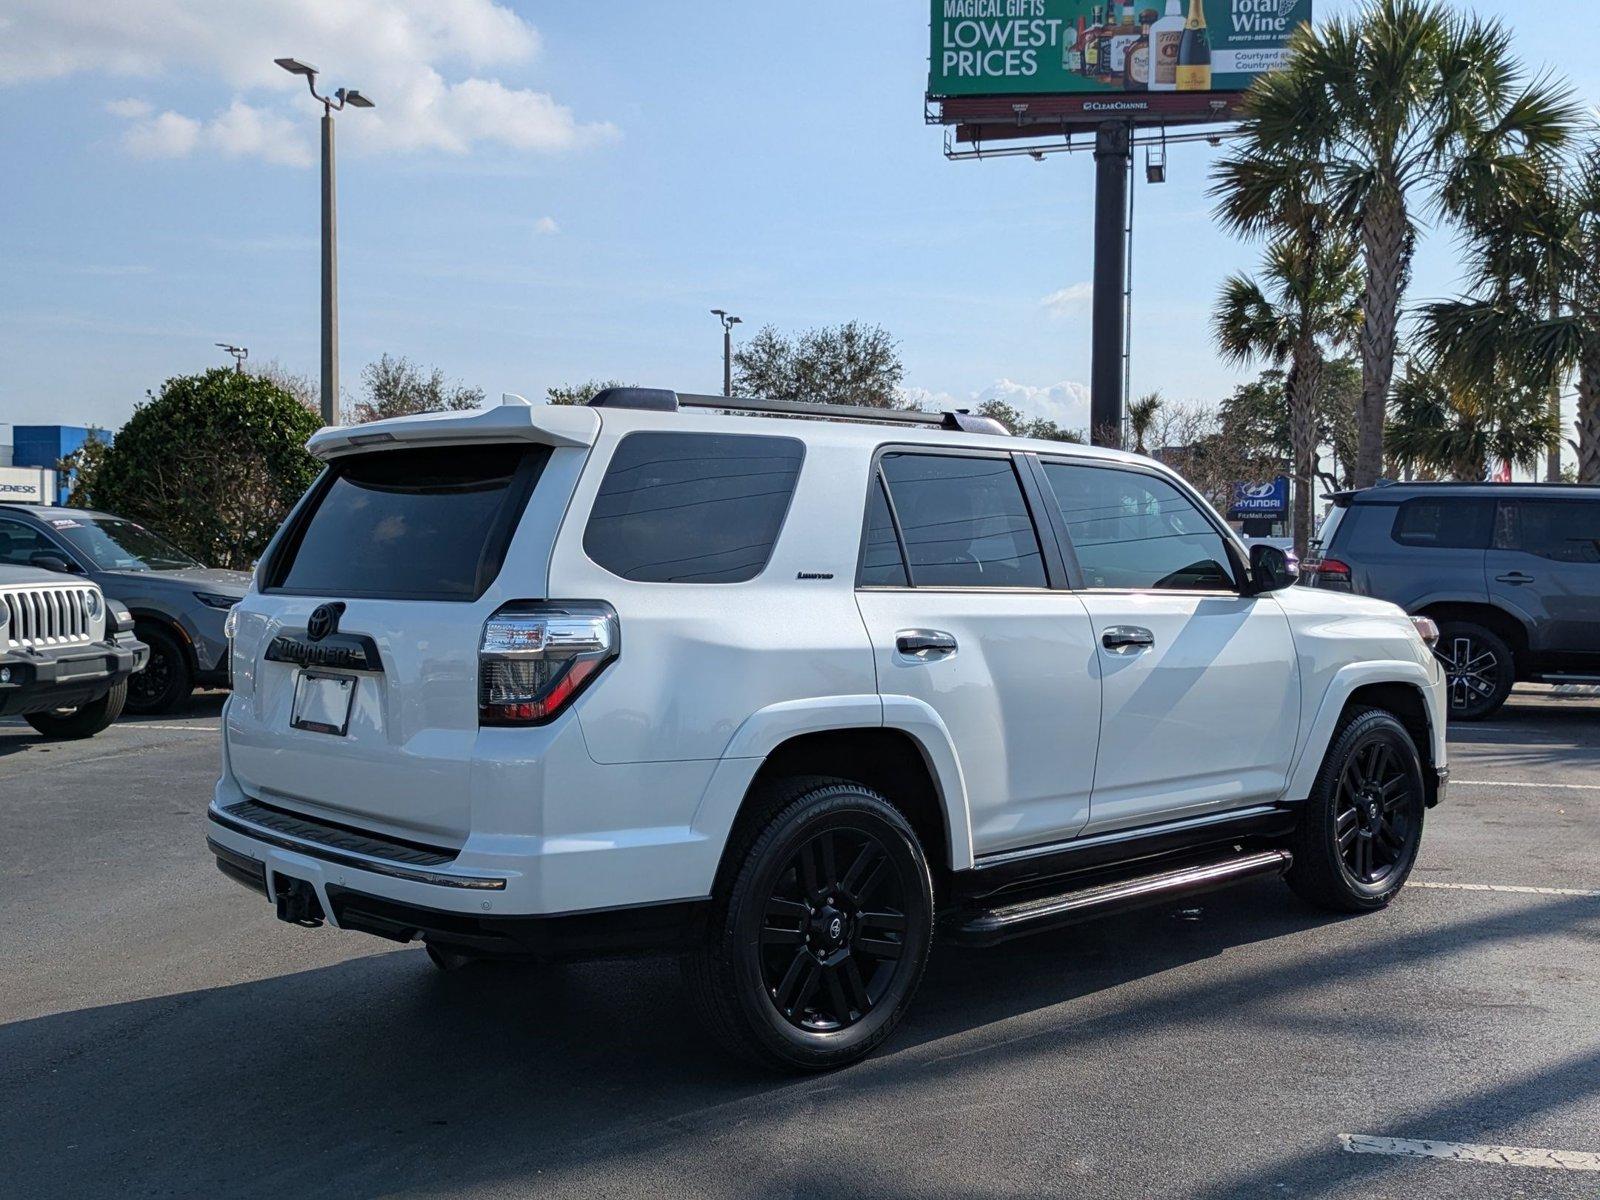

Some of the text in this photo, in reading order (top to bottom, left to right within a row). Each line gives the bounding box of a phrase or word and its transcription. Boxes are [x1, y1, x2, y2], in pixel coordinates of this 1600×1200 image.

[943, 0, 1045, 18] MAGICAL GIFTS
[1231, 0, 1278, 13] Total
[1231, 13, 1287, 32] Wine
[943, 19, 1062, 48] LOWEST
[942, 50, 1038, 77] PRICES
[1235, 52, 1279, 61] Courtyard
[1235, 499, 1281, 508] HYUNDAI
